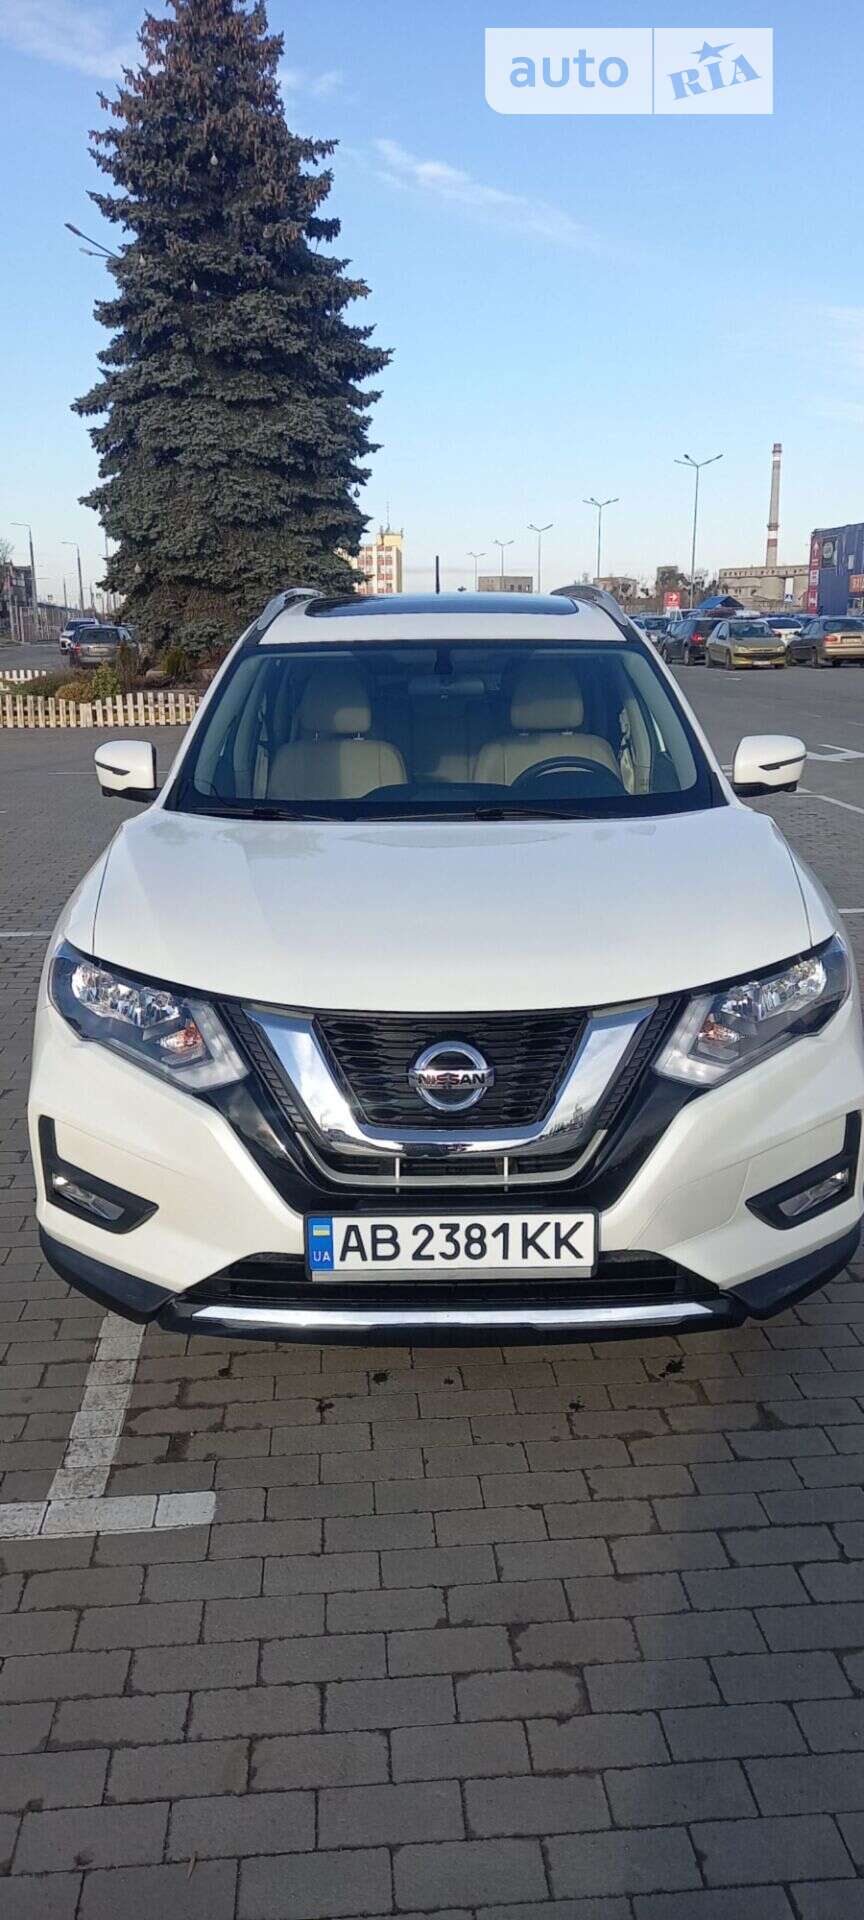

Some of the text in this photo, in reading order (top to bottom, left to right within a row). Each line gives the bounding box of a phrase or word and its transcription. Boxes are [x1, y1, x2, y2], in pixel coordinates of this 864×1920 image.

[417, 1072, 485, 1085] NISSAN
[313, 1221, 584, 1262] UA AB 2381 KK
